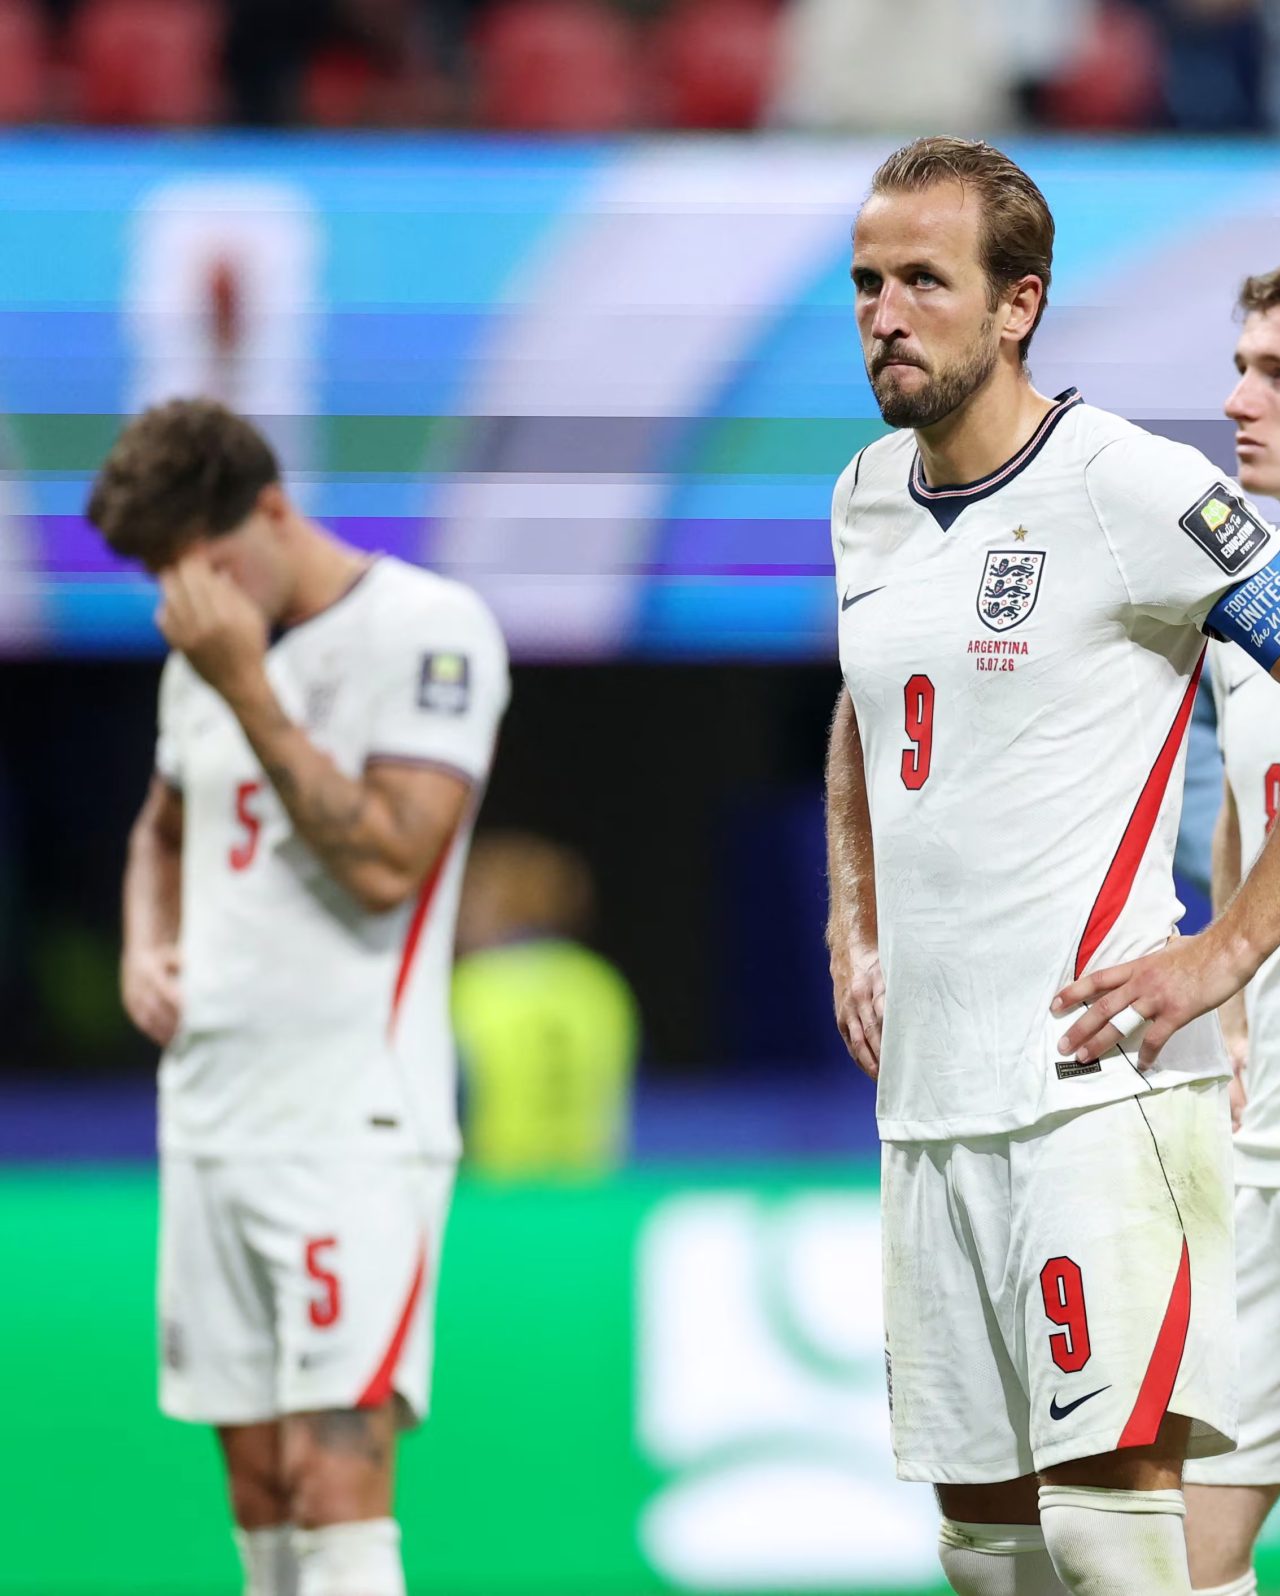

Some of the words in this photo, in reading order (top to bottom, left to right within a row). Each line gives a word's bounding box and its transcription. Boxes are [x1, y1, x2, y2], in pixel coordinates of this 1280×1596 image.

[1240, 540, 1255, 555] FIFA
[1223, 565, 1279, 618] FOOTBALL
[967, 640, 1029, 655] ARGENTINA
[1250, 627, 1270, 648] the
[976, 657, 1014, 672] 15.07.26
[900, 674, 936, 790] 9
[228, 780, 263, 873] 5
[304, 1236, 343, 1332] 5
[1040, 1255, 1092, 1374] 9
